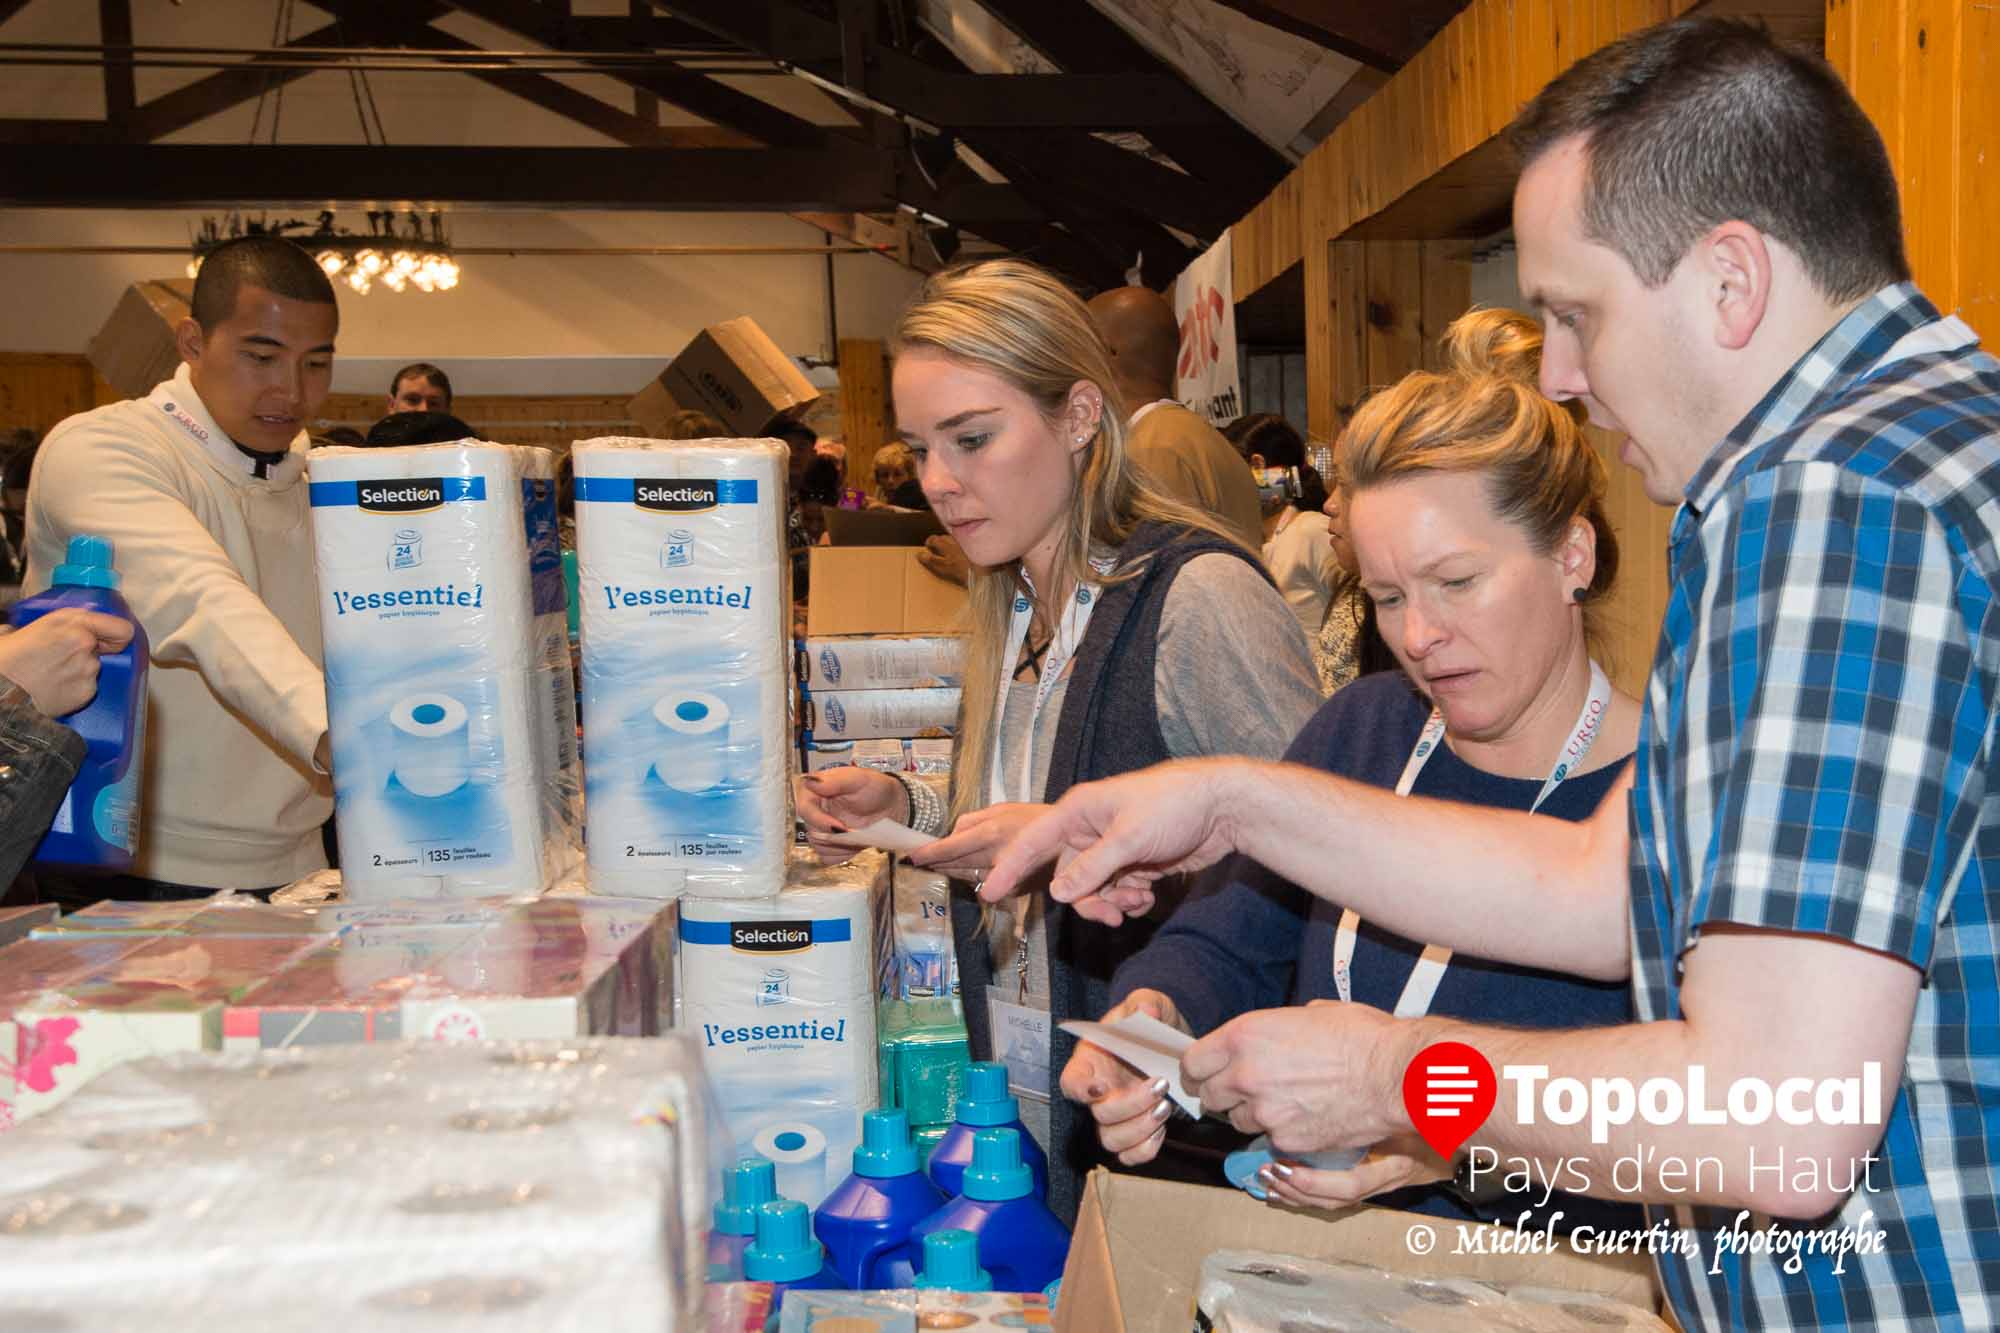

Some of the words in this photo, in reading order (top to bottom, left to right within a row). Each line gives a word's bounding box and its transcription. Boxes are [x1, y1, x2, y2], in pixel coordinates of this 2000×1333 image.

[361, 487, 441, 504] Selection
[637, 487, 715, 503] Selection
[395, 545, 411, 557] 24
[669, 544, 683, 556] 24
[333, 584, 483, 615] l'essentiel
[604, 585, 753, 609] l'essentiel
[1568, 700, 1601, 755] URGO
[427, 849, 450, 863] 135
[626, 846, 635, 857] 2
[680, 844, 703, 856] 135
[372, 855, 382, 867] 2
[735, 929, 809, 944] Selection
[765, 983, 779, 994] 24
[704, 1018, 846, 1047] l'essentiel
